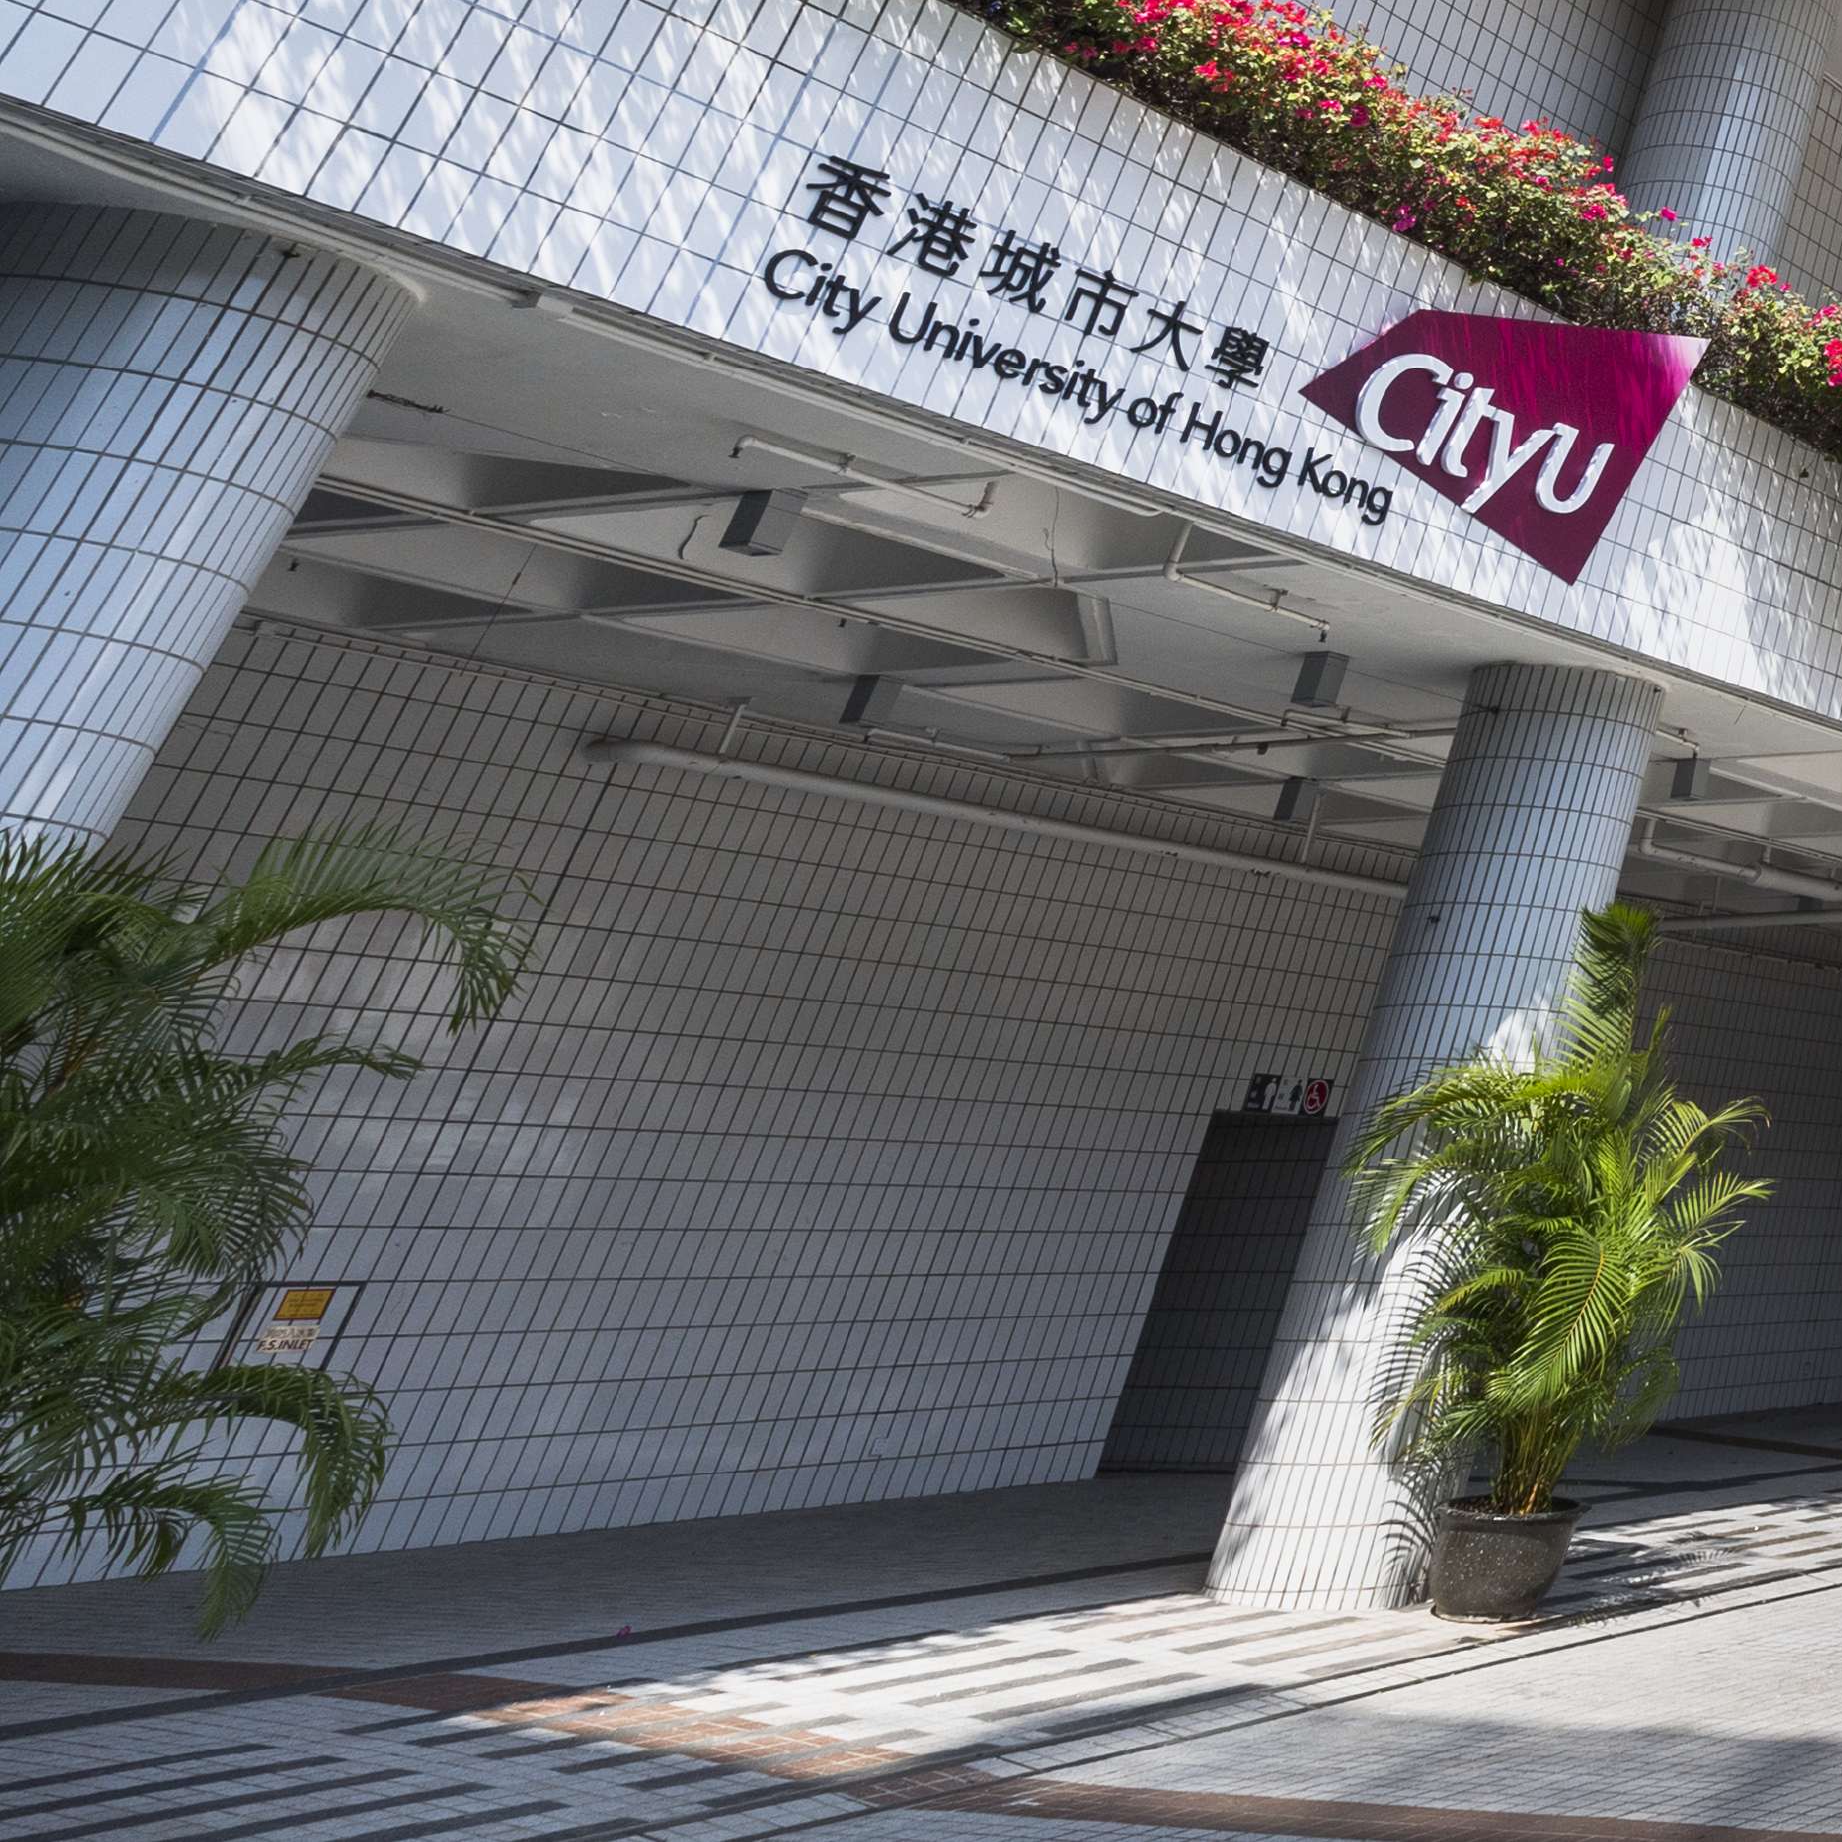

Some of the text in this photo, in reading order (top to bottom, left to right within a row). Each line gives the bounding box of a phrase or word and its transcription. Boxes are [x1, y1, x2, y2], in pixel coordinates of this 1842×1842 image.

[763, 248, 1394, 526] City University of Hong Kong
[805, 155, 1271, 390] 香港城市大學
